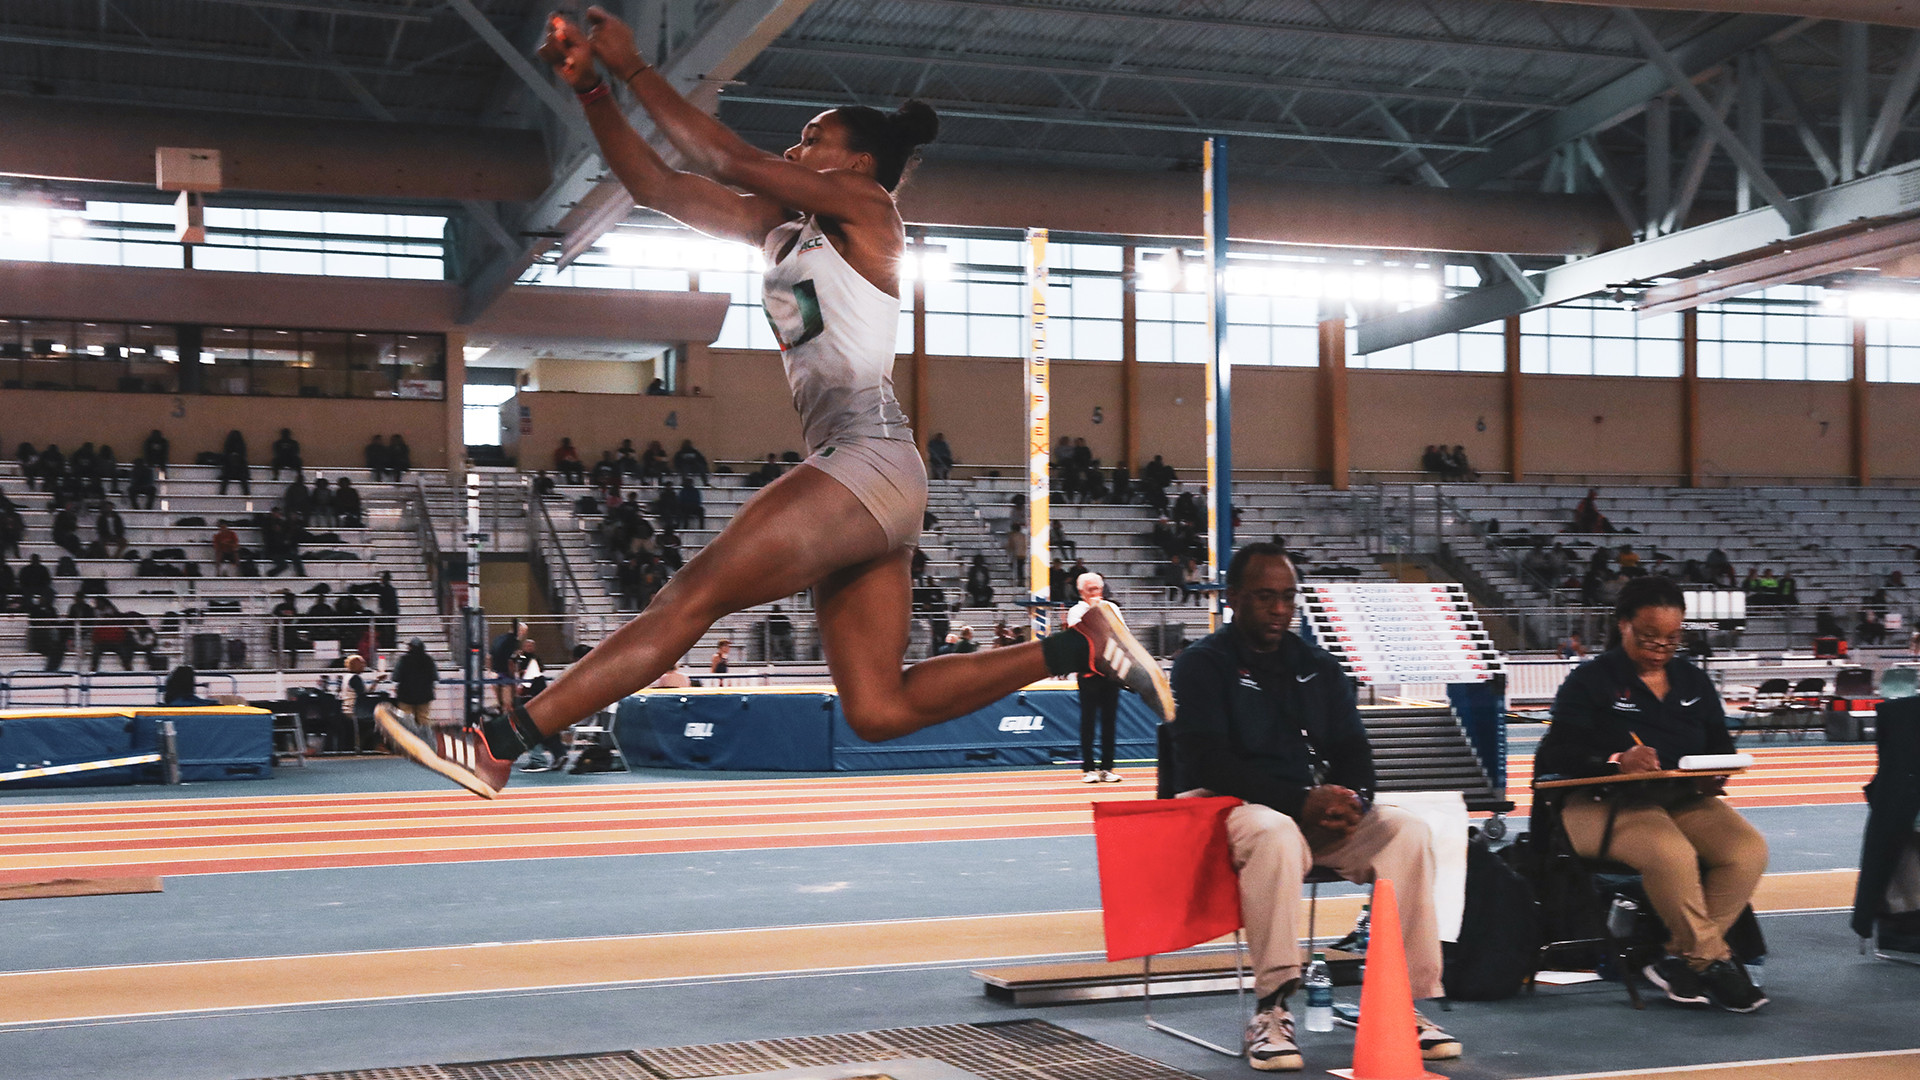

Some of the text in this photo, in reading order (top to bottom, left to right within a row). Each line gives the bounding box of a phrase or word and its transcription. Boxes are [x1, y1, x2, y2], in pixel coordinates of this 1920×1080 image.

[801, 237, 823, 250] ACC
[170, 398, 186, 417] 3
[1091, 406, 1103, 424] 5
[664, 410, 678, 428] 4
[1476, 416, 1487, 432] 6
[684, 722, 714, 737] GILL
[998, 716, 1044, 731] GILL
